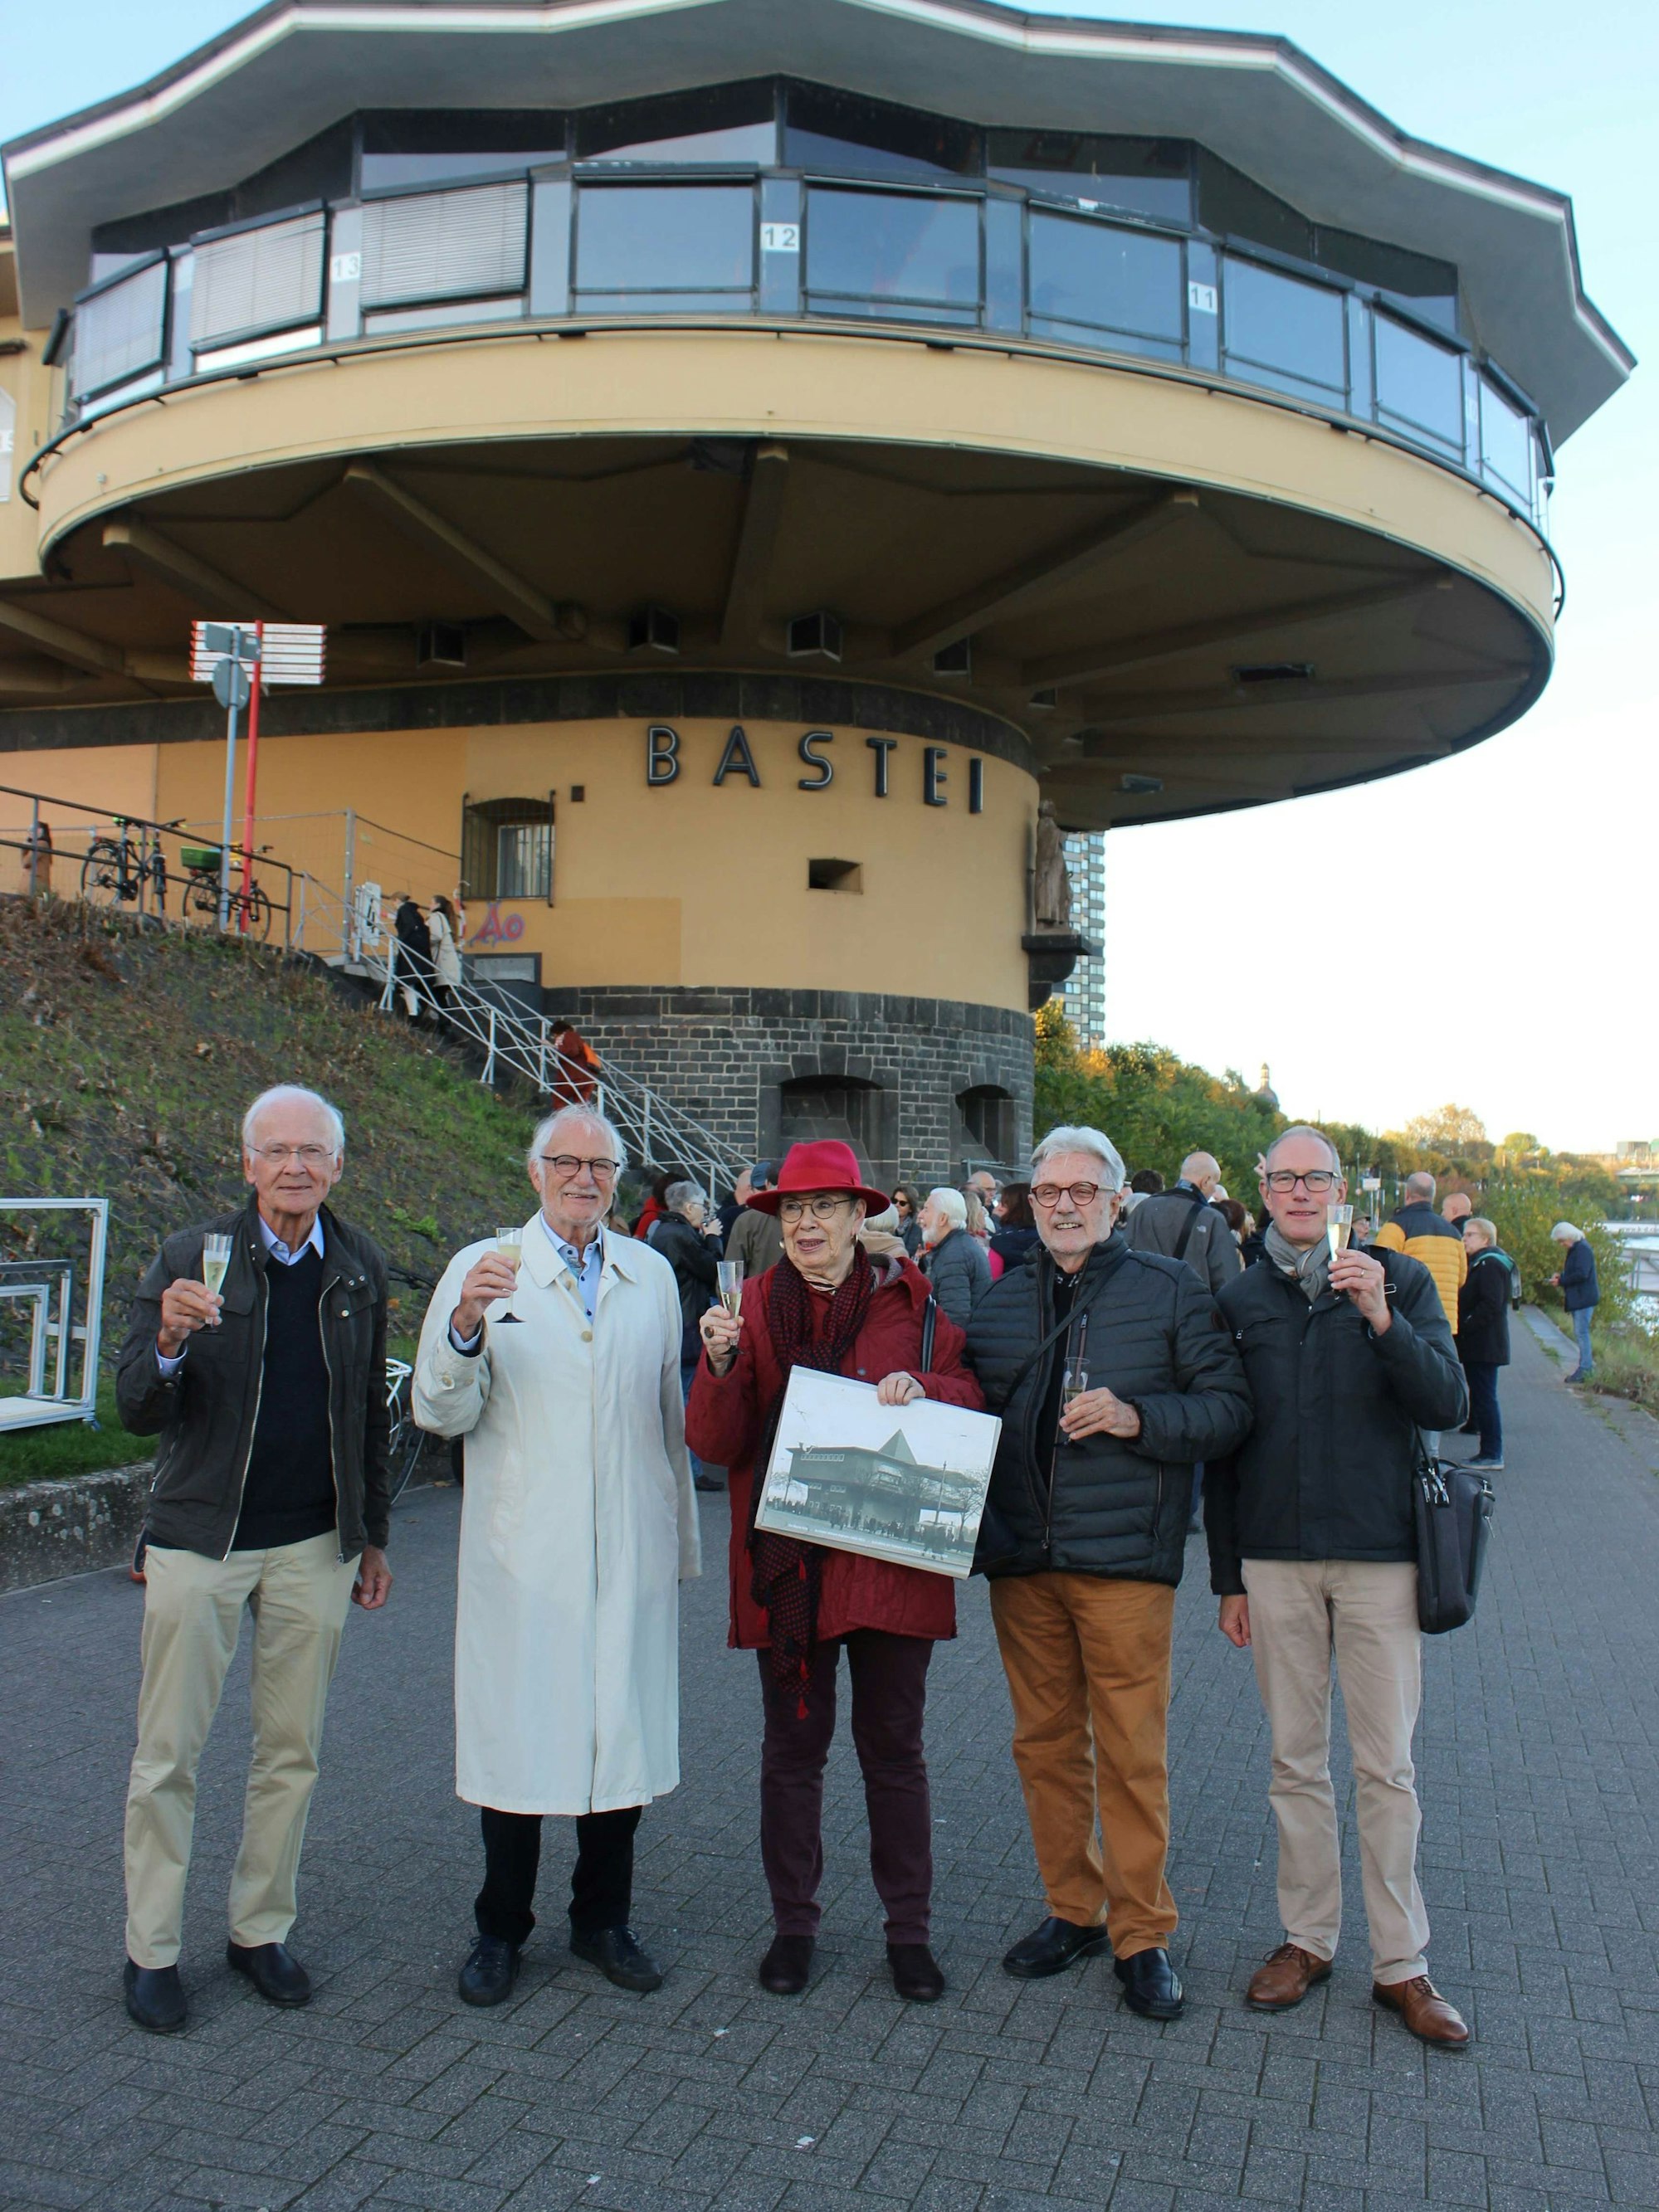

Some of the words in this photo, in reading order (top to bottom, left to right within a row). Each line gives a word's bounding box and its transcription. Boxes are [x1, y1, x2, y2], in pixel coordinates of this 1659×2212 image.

[764, 227, 796, 246] 12
[334, 256, 359, 278] 13
[1191, 286, 1213, 309] 11
[647, 725, 983, 814] BASTEI
